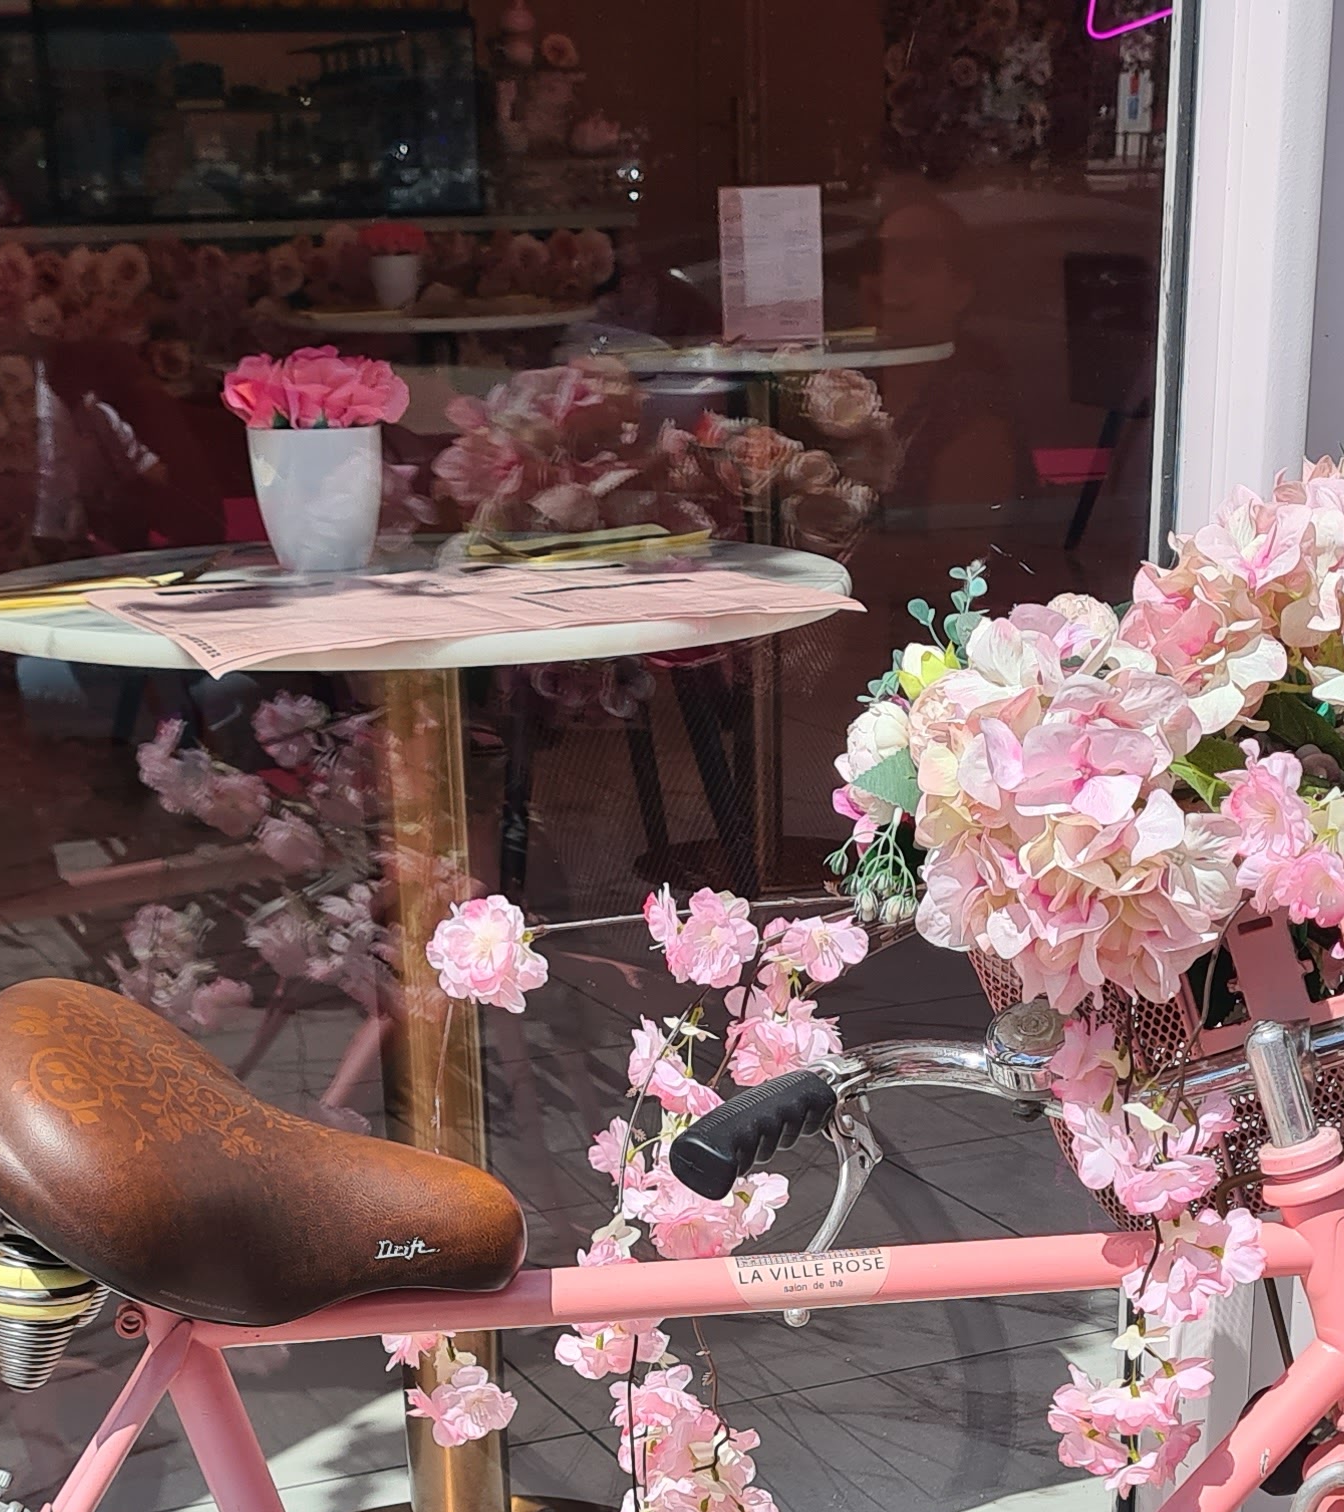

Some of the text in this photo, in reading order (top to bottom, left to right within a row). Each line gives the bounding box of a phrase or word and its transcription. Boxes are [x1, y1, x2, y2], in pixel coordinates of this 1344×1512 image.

[374, 1236, 440, 1260] Drift
[738, 1256, 885, 1285] LA VILLE ROSE
[783, 1283, 808, 1293] salon
[812, 1281, 824, 1290] de
